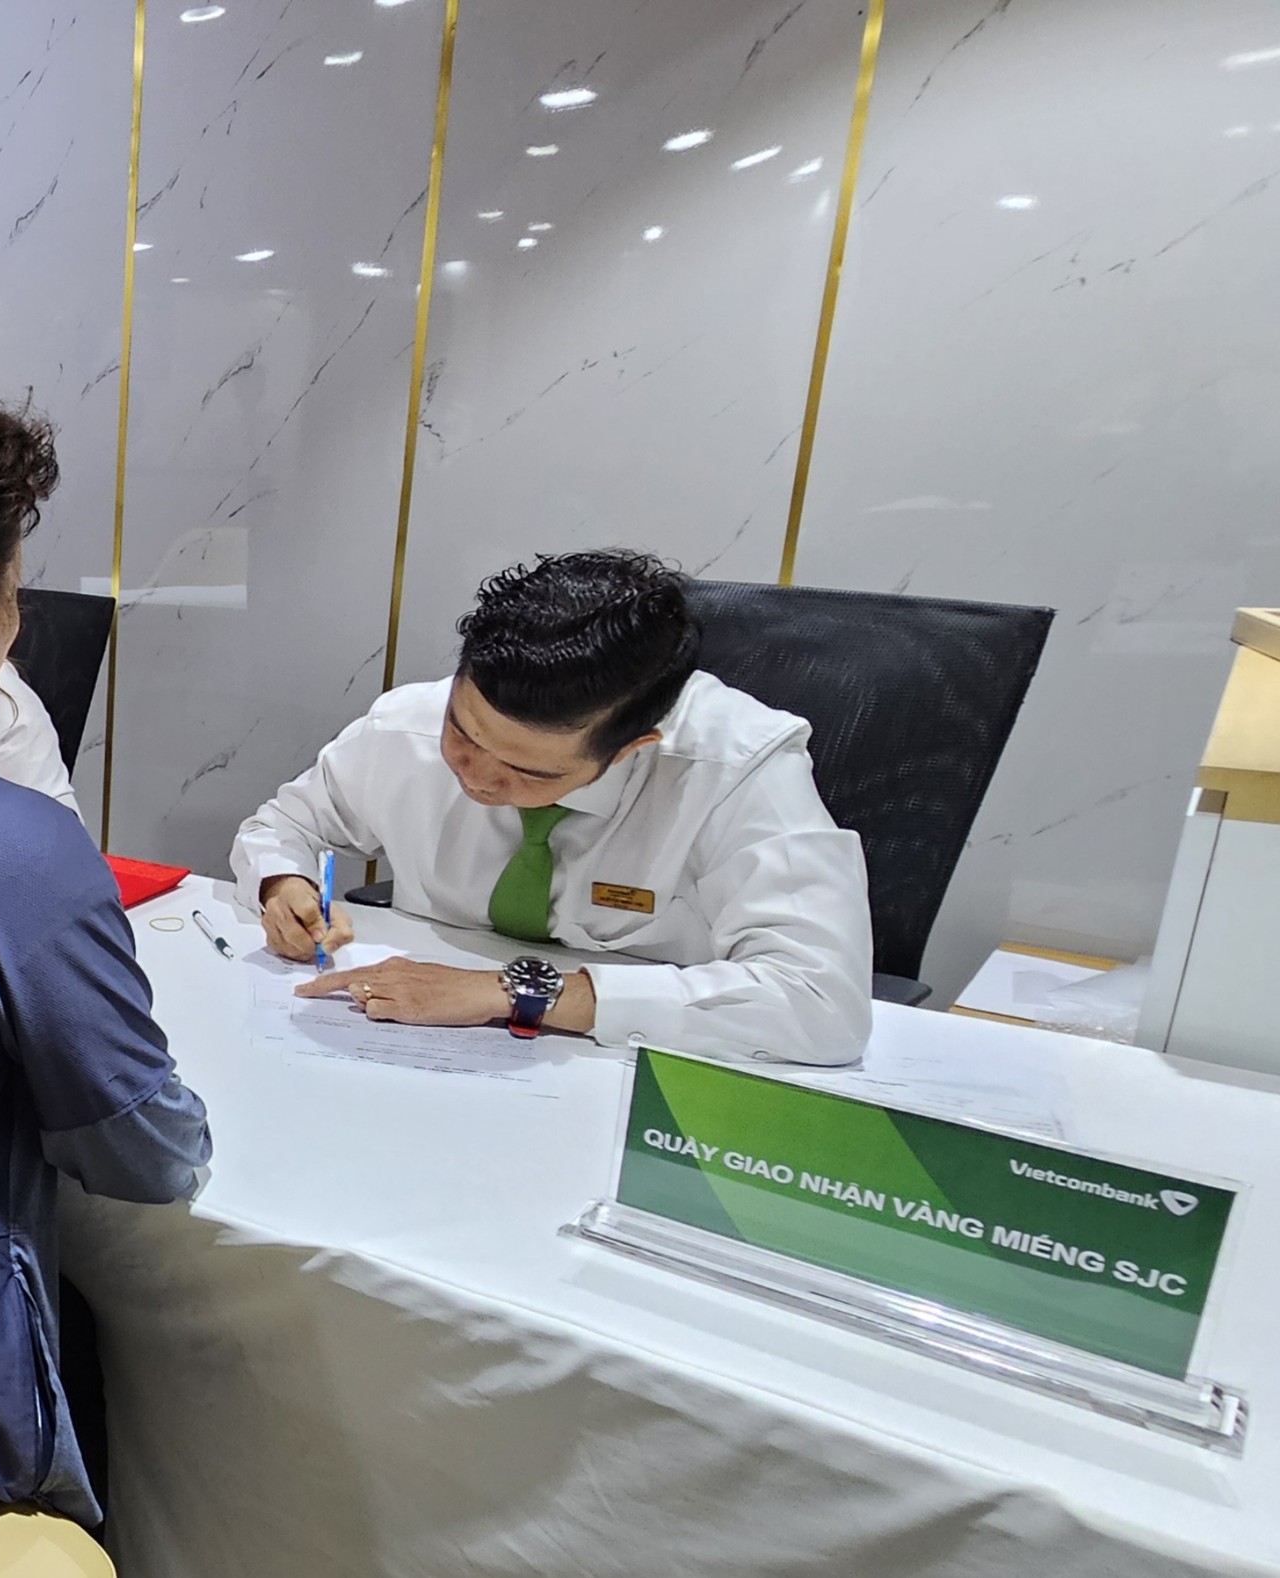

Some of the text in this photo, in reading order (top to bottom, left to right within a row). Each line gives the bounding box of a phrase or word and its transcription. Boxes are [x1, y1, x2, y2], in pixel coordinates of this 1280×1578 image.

[723, 1151, 795, 1184] GIAO
[799, 1171, 886, 1212] NHẬN
[892, 1197, 985, 1239] VÀNG
[991, 1225, 1106, 1273] MIẾNG
[1112, 1260, 1188, 1296] SJC
[1009, 1158, 1159, 1211] Vietcombank
